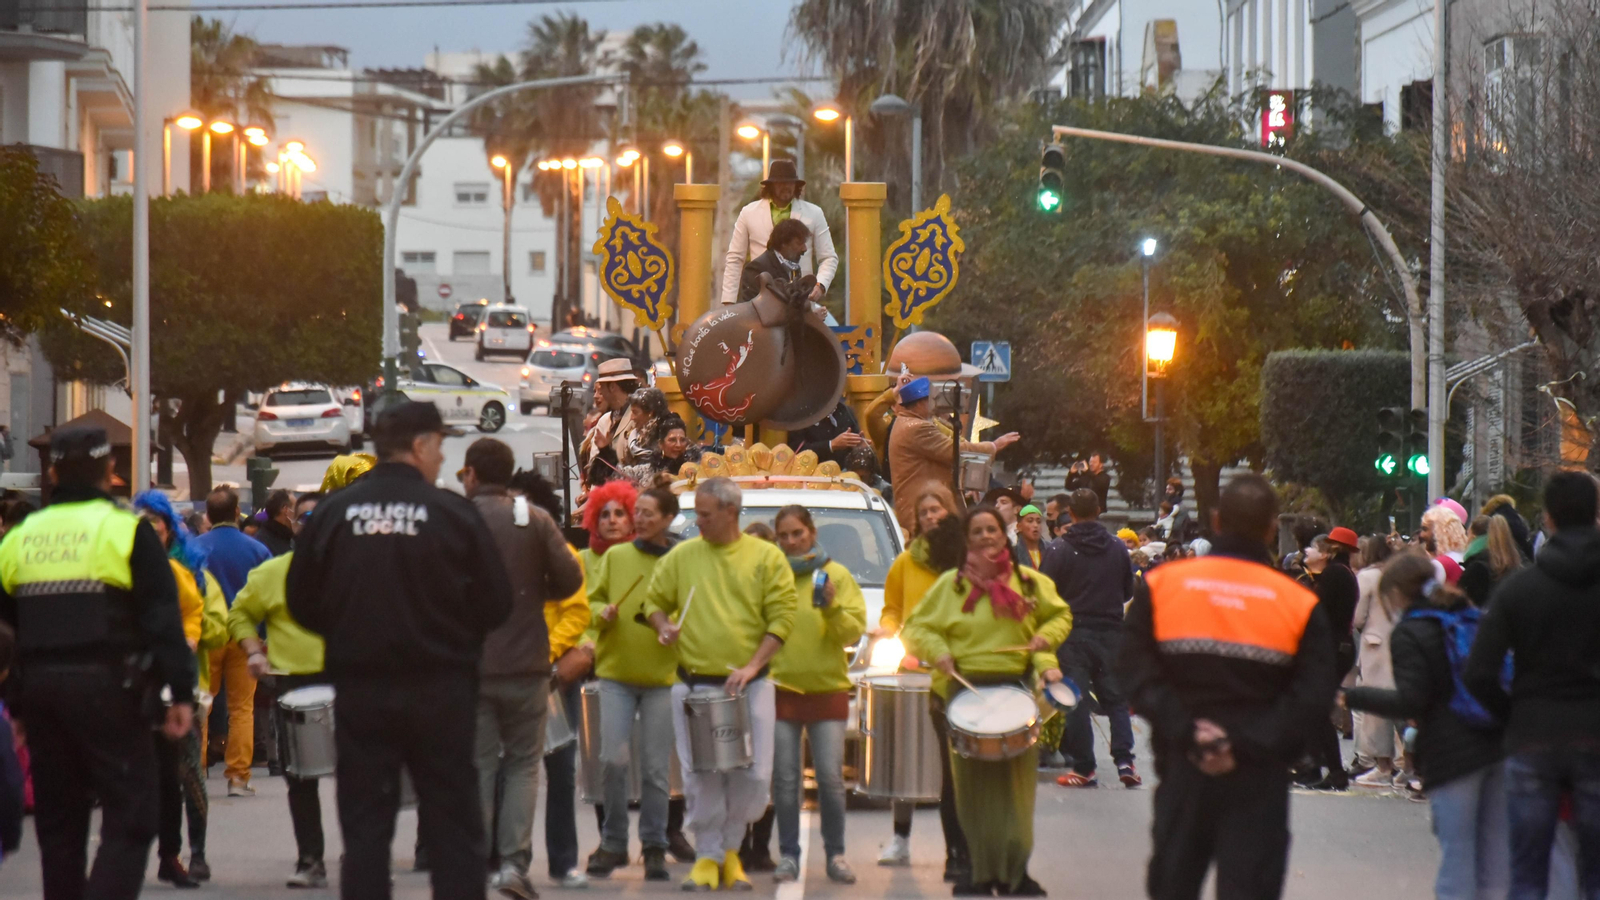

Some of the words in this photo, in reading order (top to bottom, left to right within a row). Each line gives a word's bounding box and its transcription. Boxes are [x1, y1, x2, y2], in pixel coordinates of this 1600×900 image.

[690, 326, 710, 348] bonita
[707, 317, 719, 327] la
[345, 502, 428, 522] POLICIA
[352, 519, 419, 536] LOCAL
[22, 531, 89, 549] POLICIA
[25, 548, 81, 565] LOCAL
